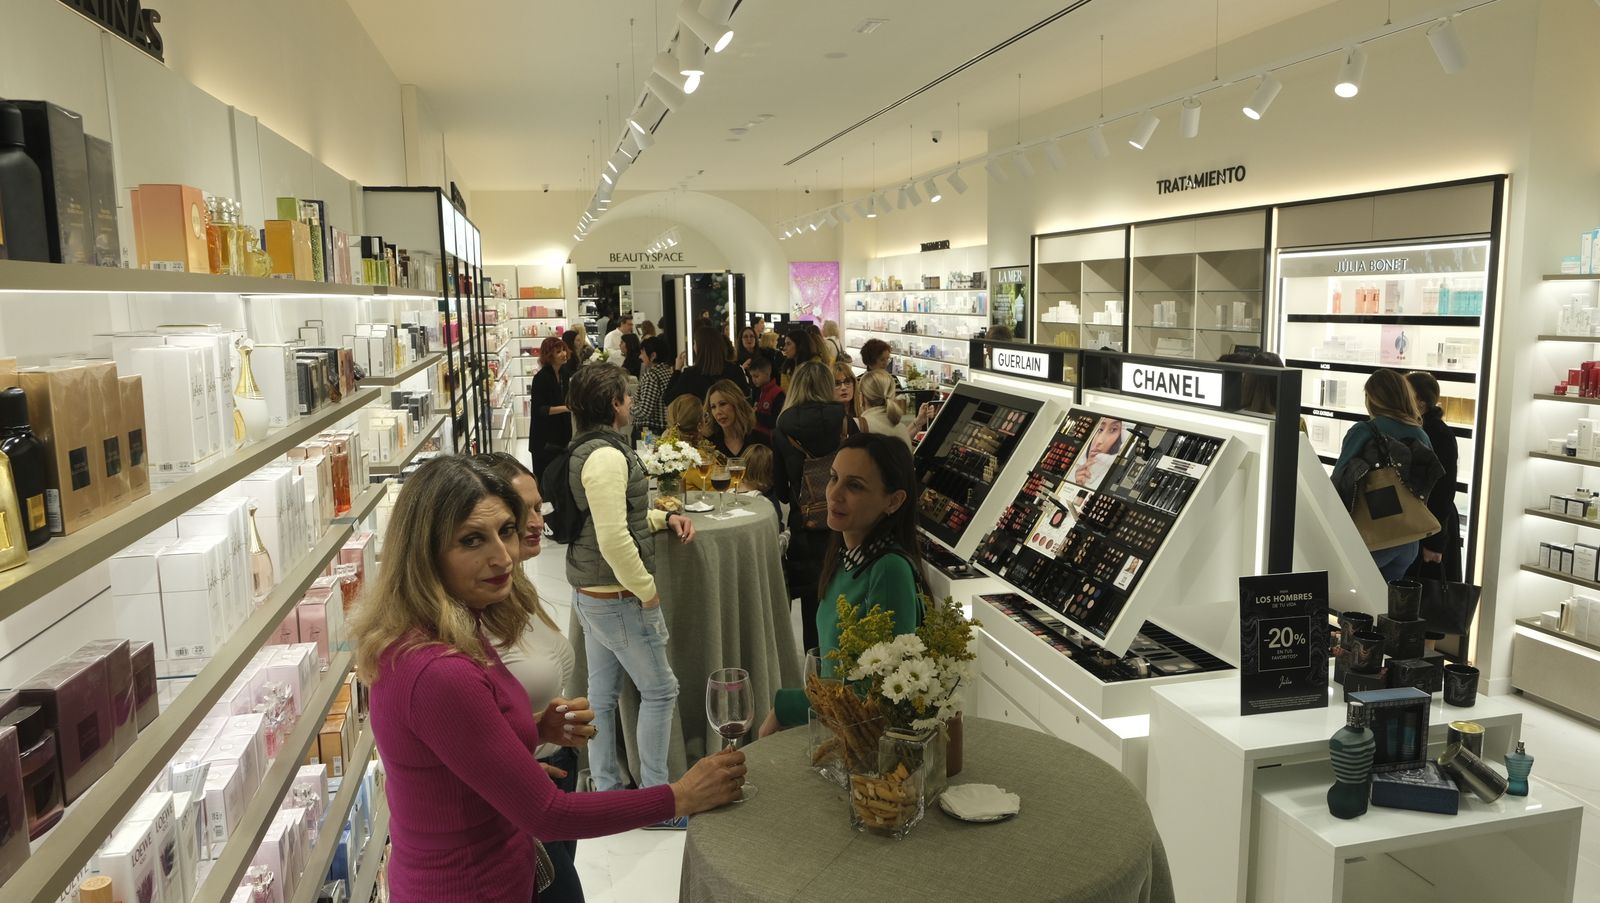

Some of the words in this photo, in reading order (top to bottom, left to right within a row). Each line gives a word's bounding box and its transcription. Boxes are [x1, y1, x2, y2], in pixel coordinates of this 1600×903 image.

[1156, 165, 1246, 195] TRATAMIENTO
[609, 252, 684, 262] BEAUTYSPACE
[1335, 258, 1366, 272] JÚLIA
[1369, 258, 1408, 271] BONET
[998, 271, 1007, 282] LA
[1008, 270, 1022, 282] MER
[998, 353, 1041, 372] GUERLAIN
[1133, 368, 1205, 399] CHANEL
[1255, 596, 1271, 604] LOS
[1273, 592, 1313, 602] HOMBRES
[1263, 626, 1306, 648] -20%
[155, 802, 173, 833] LOEWE
[131, 832, 152, 868] LOEWE
